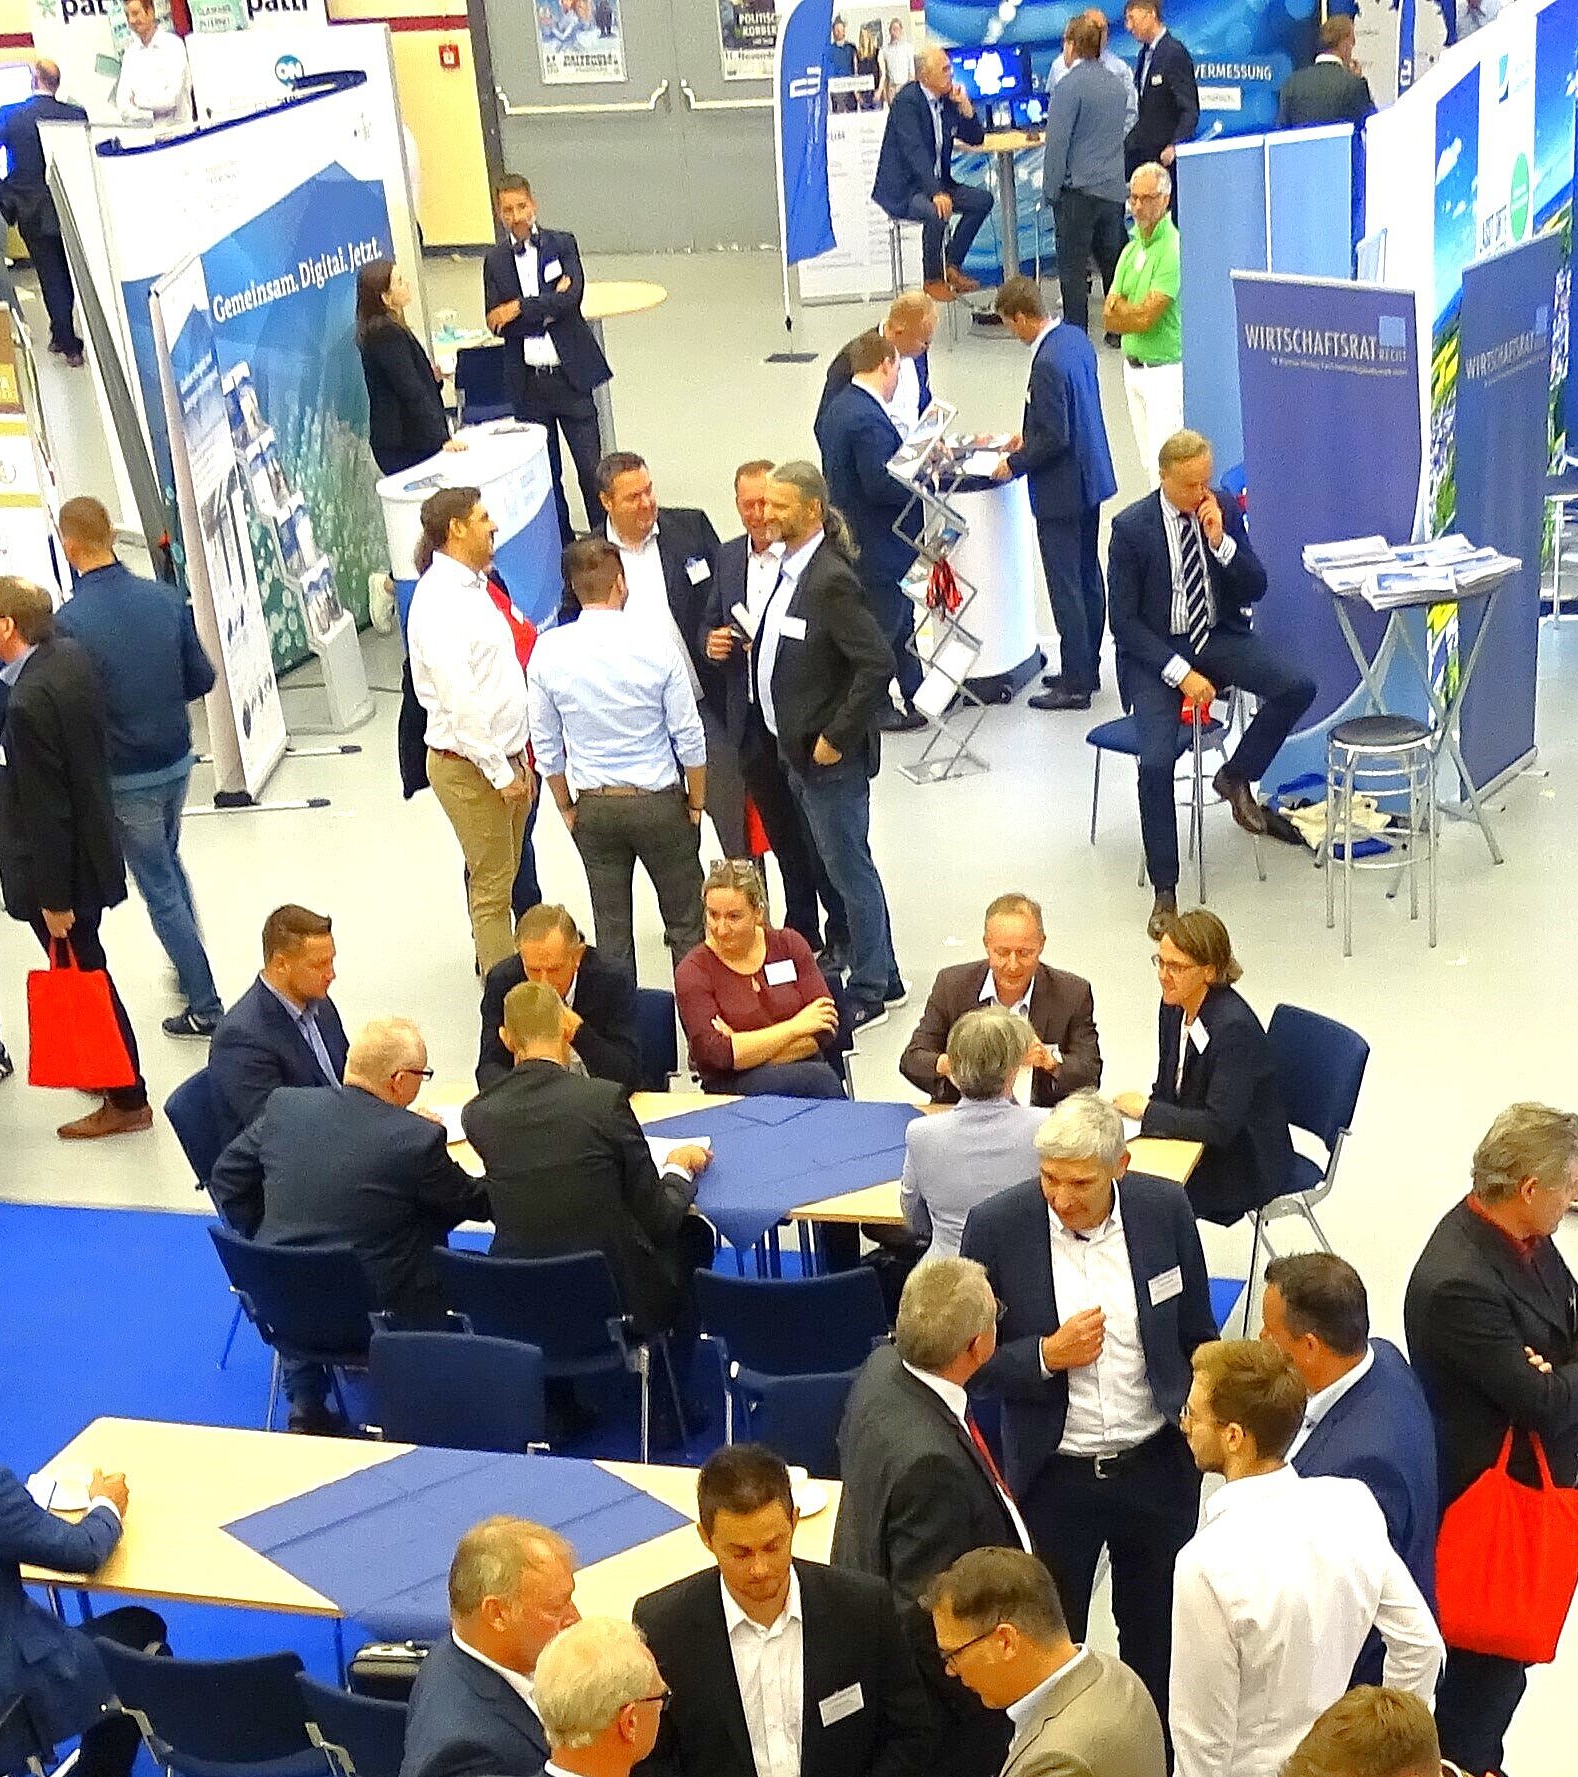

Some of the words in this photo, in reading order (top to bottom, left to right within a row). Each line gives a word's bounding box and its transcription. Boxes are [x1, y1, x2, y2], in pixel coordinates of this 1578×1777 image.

[1194, 63, 1272, 81] VERMESSUNG
[213, 272, 299, 323] Gemeinsam.
[298, 246, 348, 289] Digital.
[348, 236, 383, 273] Jetzt.
[1245, 323, 1378, 361] WIRTSCHAFTSRAT
